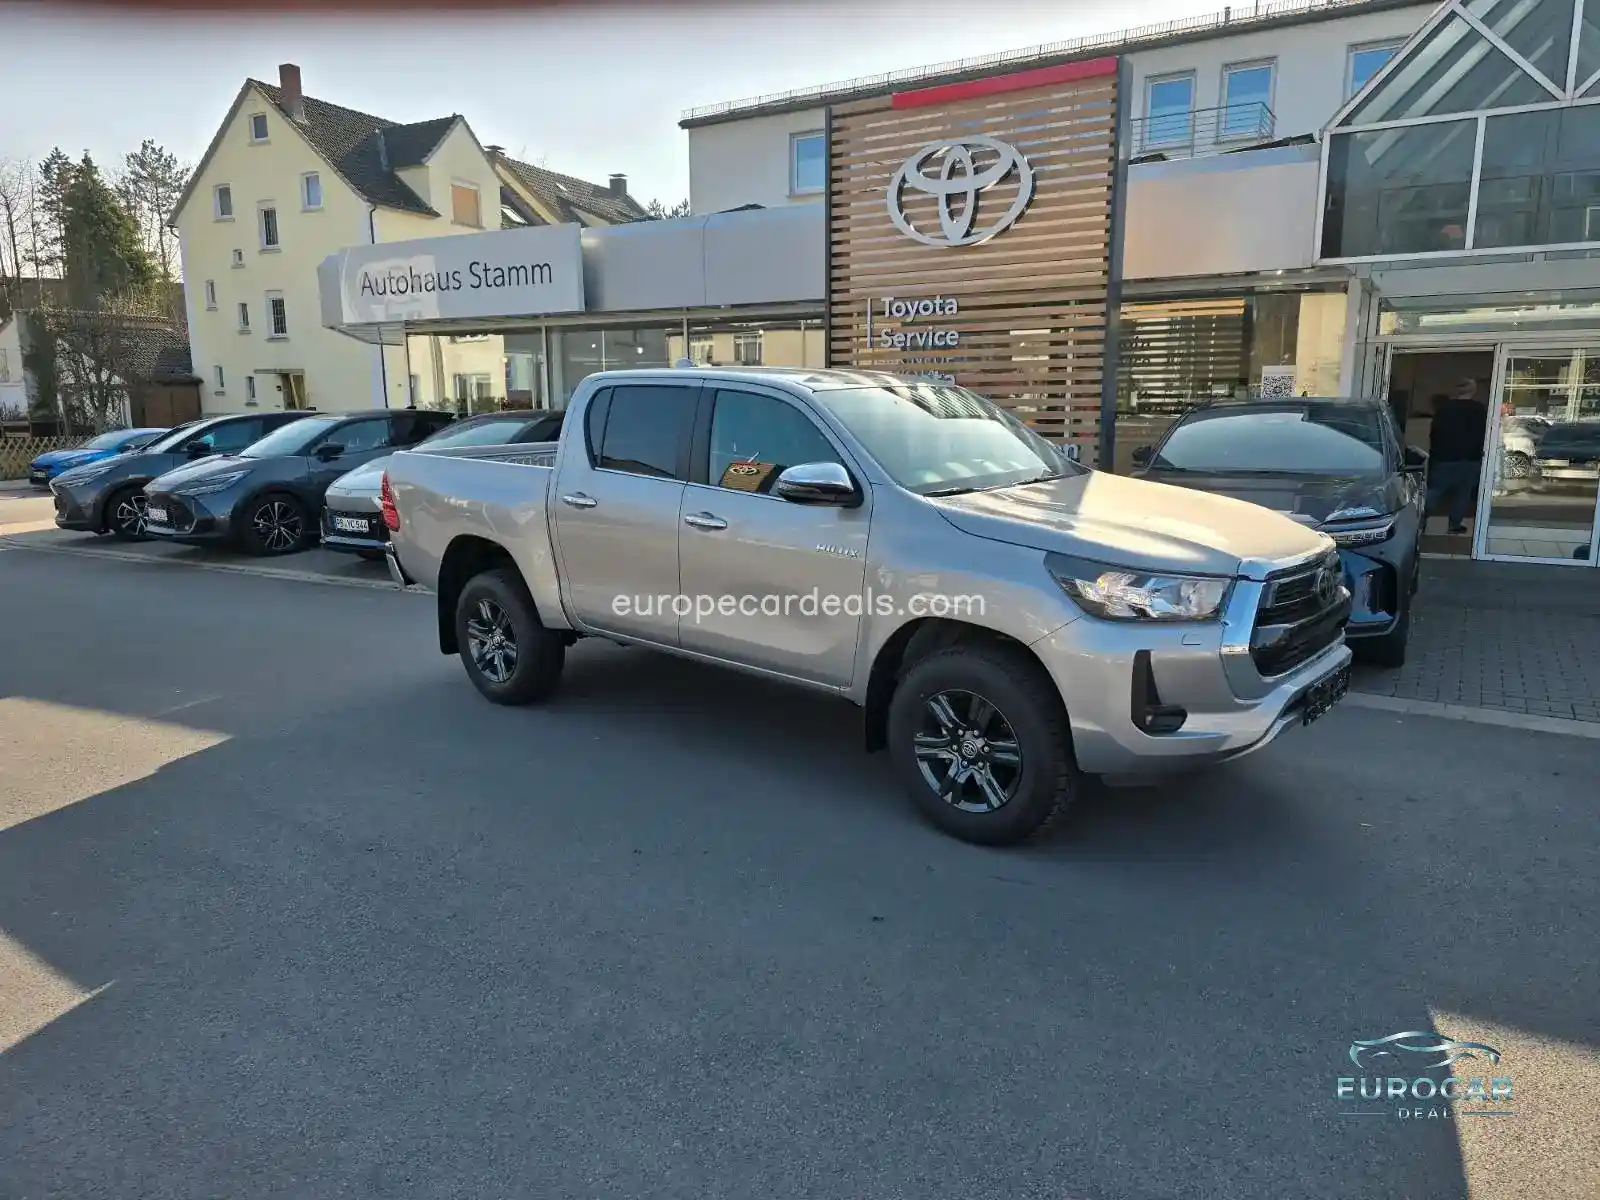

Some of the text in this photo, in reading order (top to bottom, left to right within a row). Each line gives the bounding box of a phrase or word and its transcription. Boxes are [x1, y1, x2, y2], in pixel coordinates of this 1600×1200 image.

[360, 260, 554, 297] Autohaus Stamm
[881, 295, 959, 322] Toyota
[880, 326, 960, 348] Service
